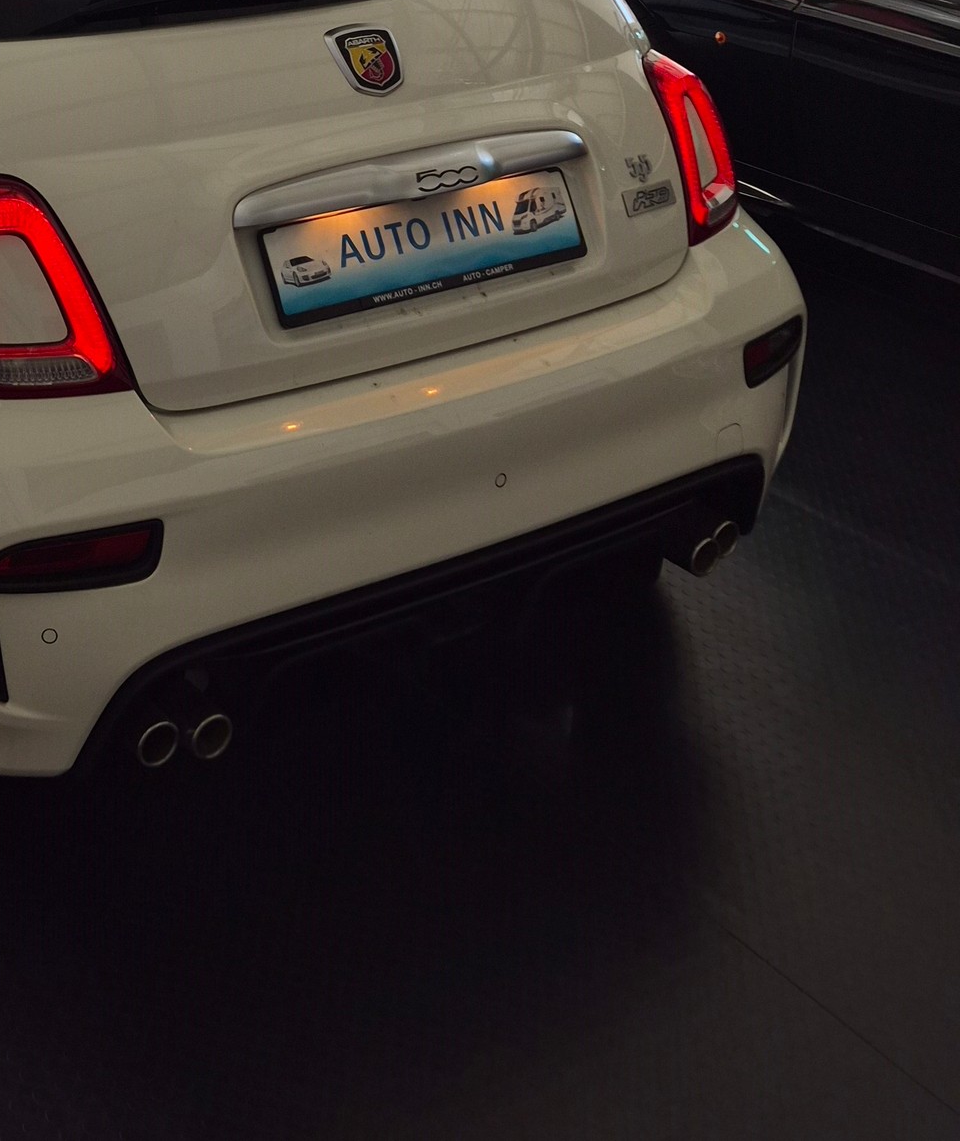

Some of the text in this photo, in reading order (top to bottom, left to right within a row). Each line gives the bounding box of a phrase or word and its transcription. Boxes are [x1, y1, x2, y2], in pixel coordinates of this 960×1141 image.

[348, 37, 381, 46] ABARTH
[416, 166, 479, 192] 500
[340, 200, 504, 268] AUTO INN
[486, 263, 514, 276] CAMPER
